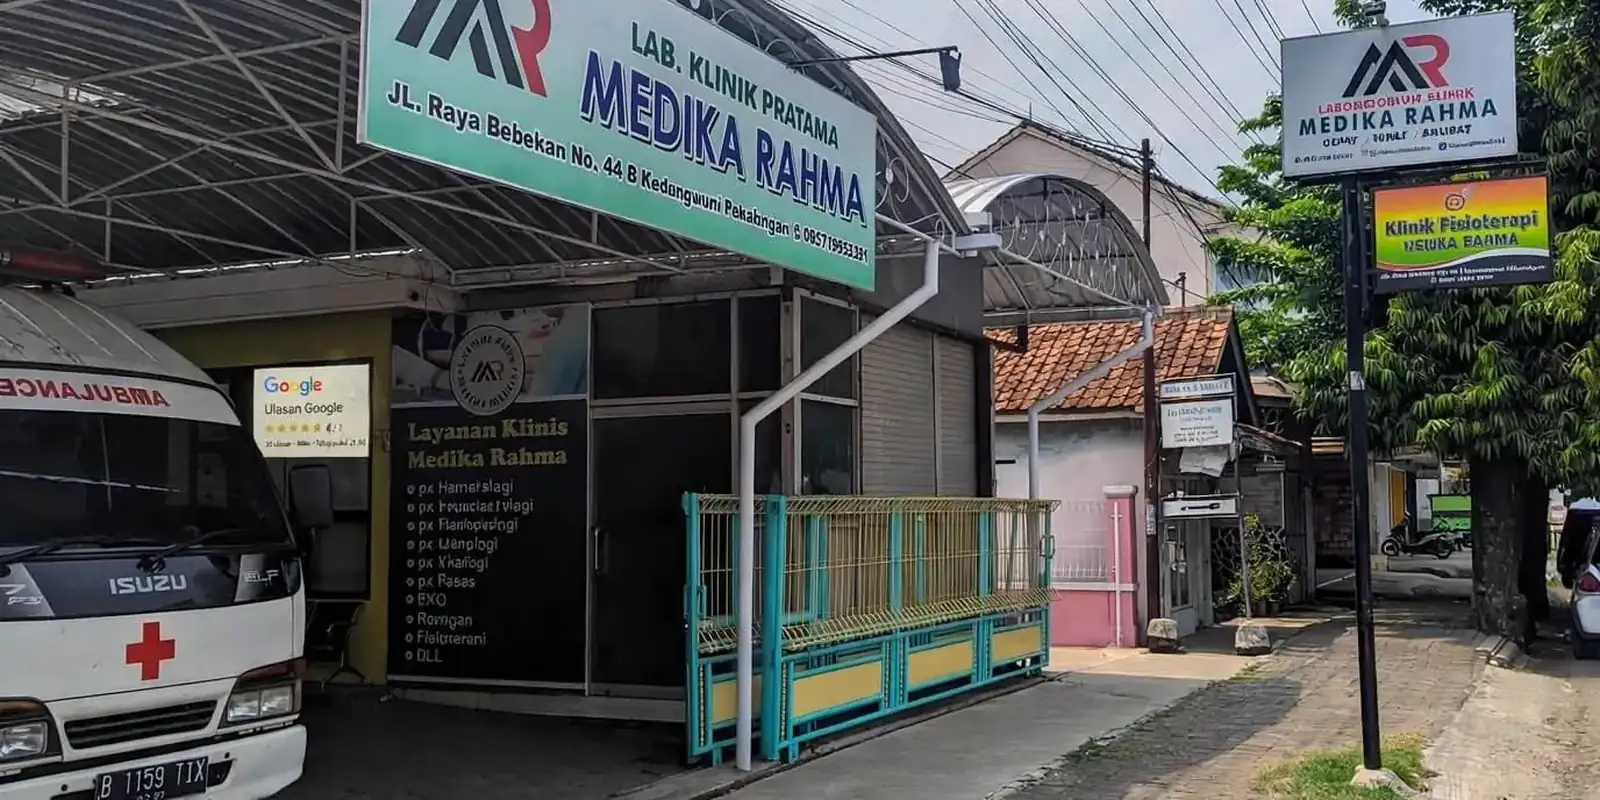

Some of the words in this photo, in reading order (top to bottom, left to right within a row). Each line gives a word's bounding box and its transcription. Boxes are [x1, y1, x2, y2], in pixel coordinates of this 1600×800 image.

[631, 21, 682, 73] LAB.
[690, 51, 758, 110] KLINIK
[762, 89, 839, 149] PRATAMA
[1299, 110, 1394, 136] MEDIKA
[1405, 98, 1498, 125] RAHMA
[387, 82, 421, 112] JL.
[428, 93, 480, 131] Raya
[487, 114, 566, 160] Bebekan
[571, 145, 599, 172] No.
[603, 157, 622, 180] 44
[580, 49, 746, 182] MEDIKA
[756, 128, 867, 228] RAHMA
[1385, 217, 1434, 236] Klinik
[264, 375, 323, 396] Google
[264, 403, 302, 415] Ulasan
[304, 401, 344, 416] Google
[407, 423, 497, 444] Layanan
[501, 417, 569, 438] Klinis
[407, 449, 484, 469] Medika
[489, 446, 568, 467] Rahma
[108, 574, 188, 595] ISUZU
[416, 648, 443, 662] DLL
[100, 775, 112, 799] B
[126, 766, 165, 794] 1159
[176, 758, 206, 786] TIX
